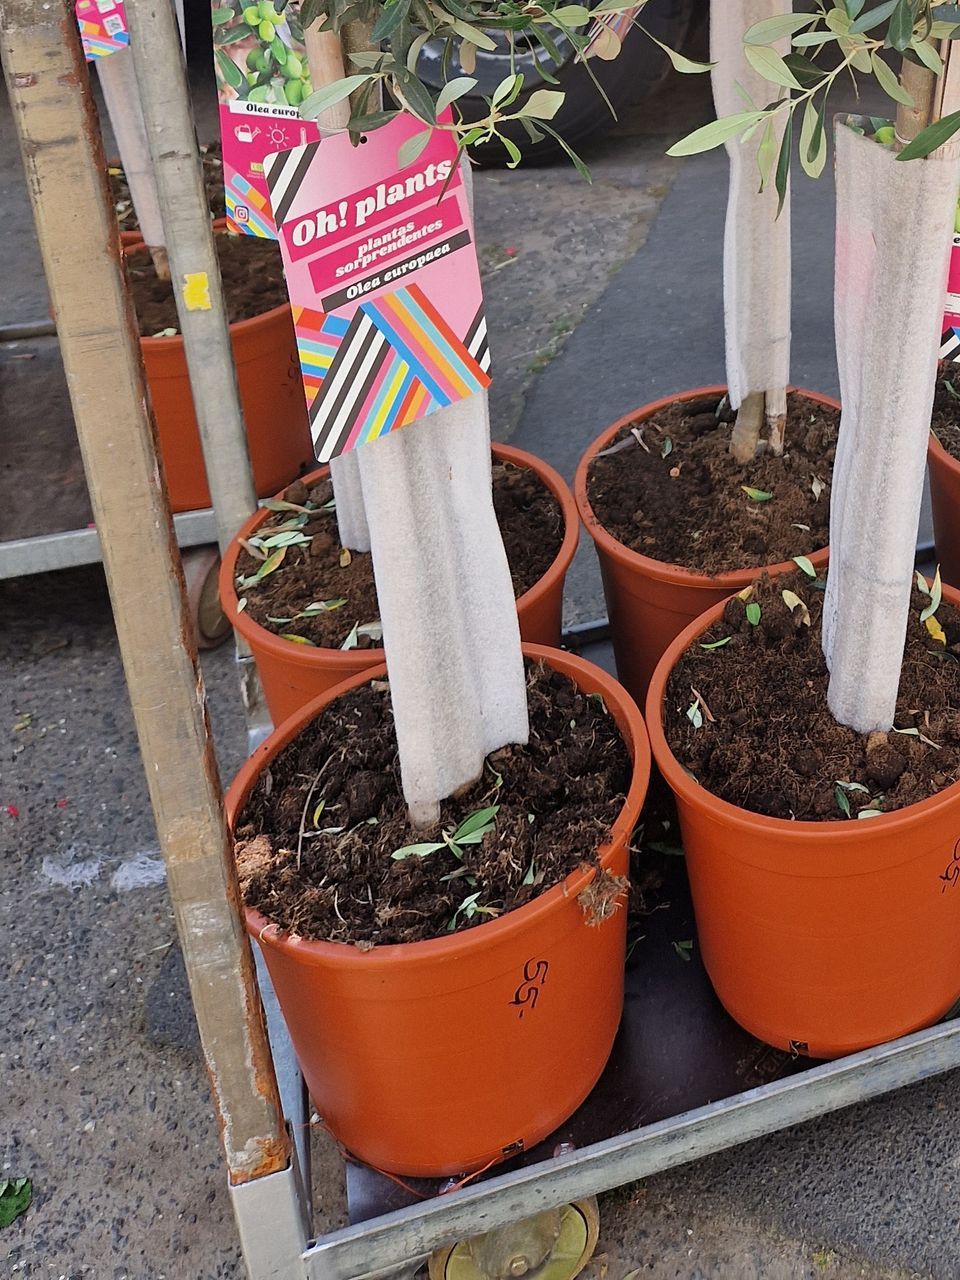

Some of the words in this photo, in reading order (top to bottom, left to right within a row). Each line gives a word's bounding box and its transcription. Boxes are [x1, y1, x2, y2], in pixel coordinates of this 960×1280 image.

[246, 103, 270, 114] Olea
[292, 201, 348, 247] Oh!
[354, 159, 453, 228] plants
[335, 219, 444, 278] sorprendentes
[357, 221, 416, 259] plantas
[346, 276, 381, 300] Olea
[383, 243, 451, 283] europaea
